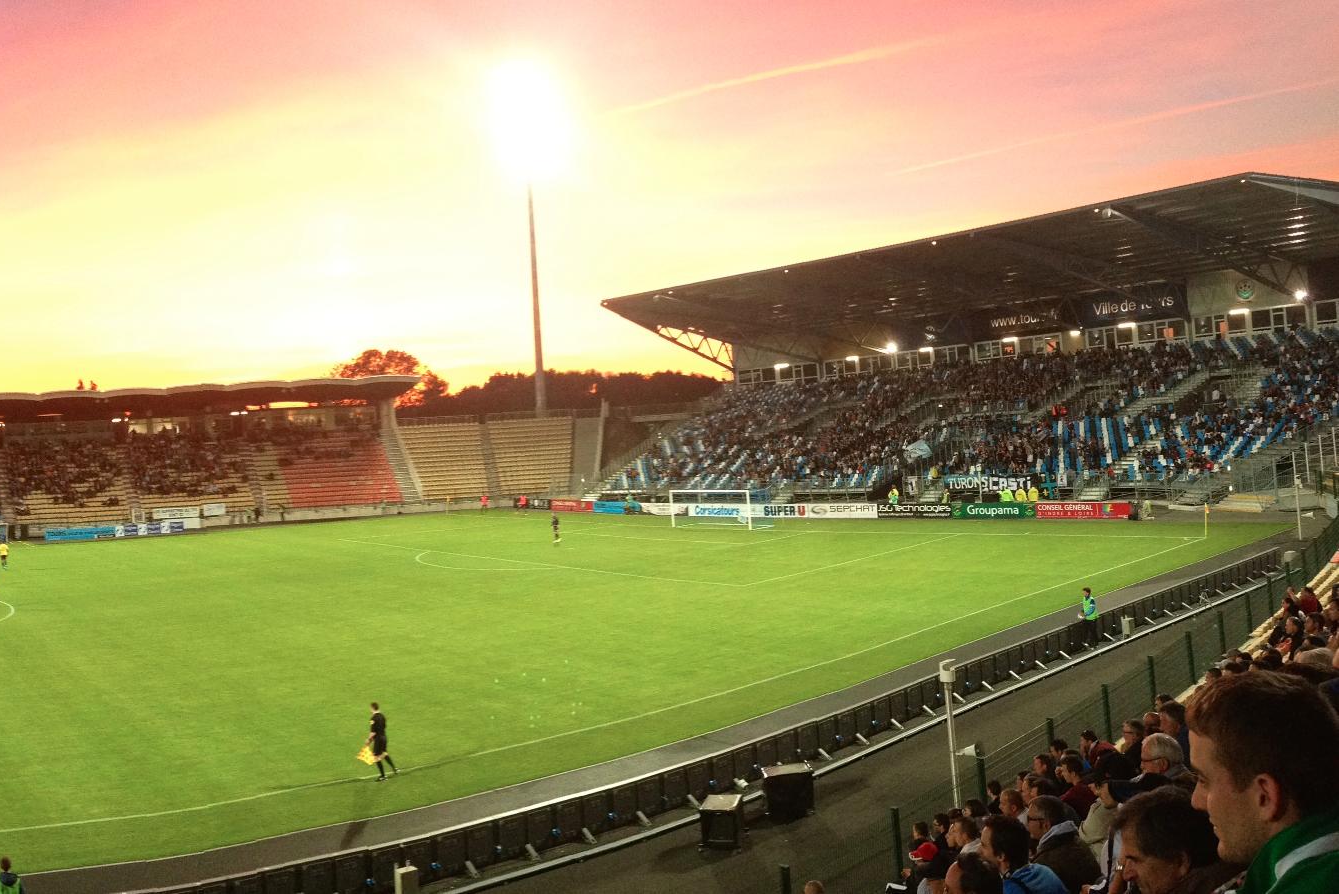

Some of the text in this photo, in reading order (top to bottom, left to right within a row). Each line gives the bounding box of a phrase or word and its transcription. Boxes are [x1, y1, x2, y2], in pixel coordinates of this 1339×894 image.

[1093, 301, 1118, 315] Ville
[1121, 300, 1136, 311] de
[948, 477, 988, 489] TURONS
[694, 505, 740, 516] Corsicatours
[763, 505, 806, 516] SUPER U
[829, 505, 875, 513] SEPCHAT
[893, 504, 951, 512] Technologies
[966, 504, 1020, 517] Groupama
[1064, 503, 1094, 511] GÉNÉRAL
